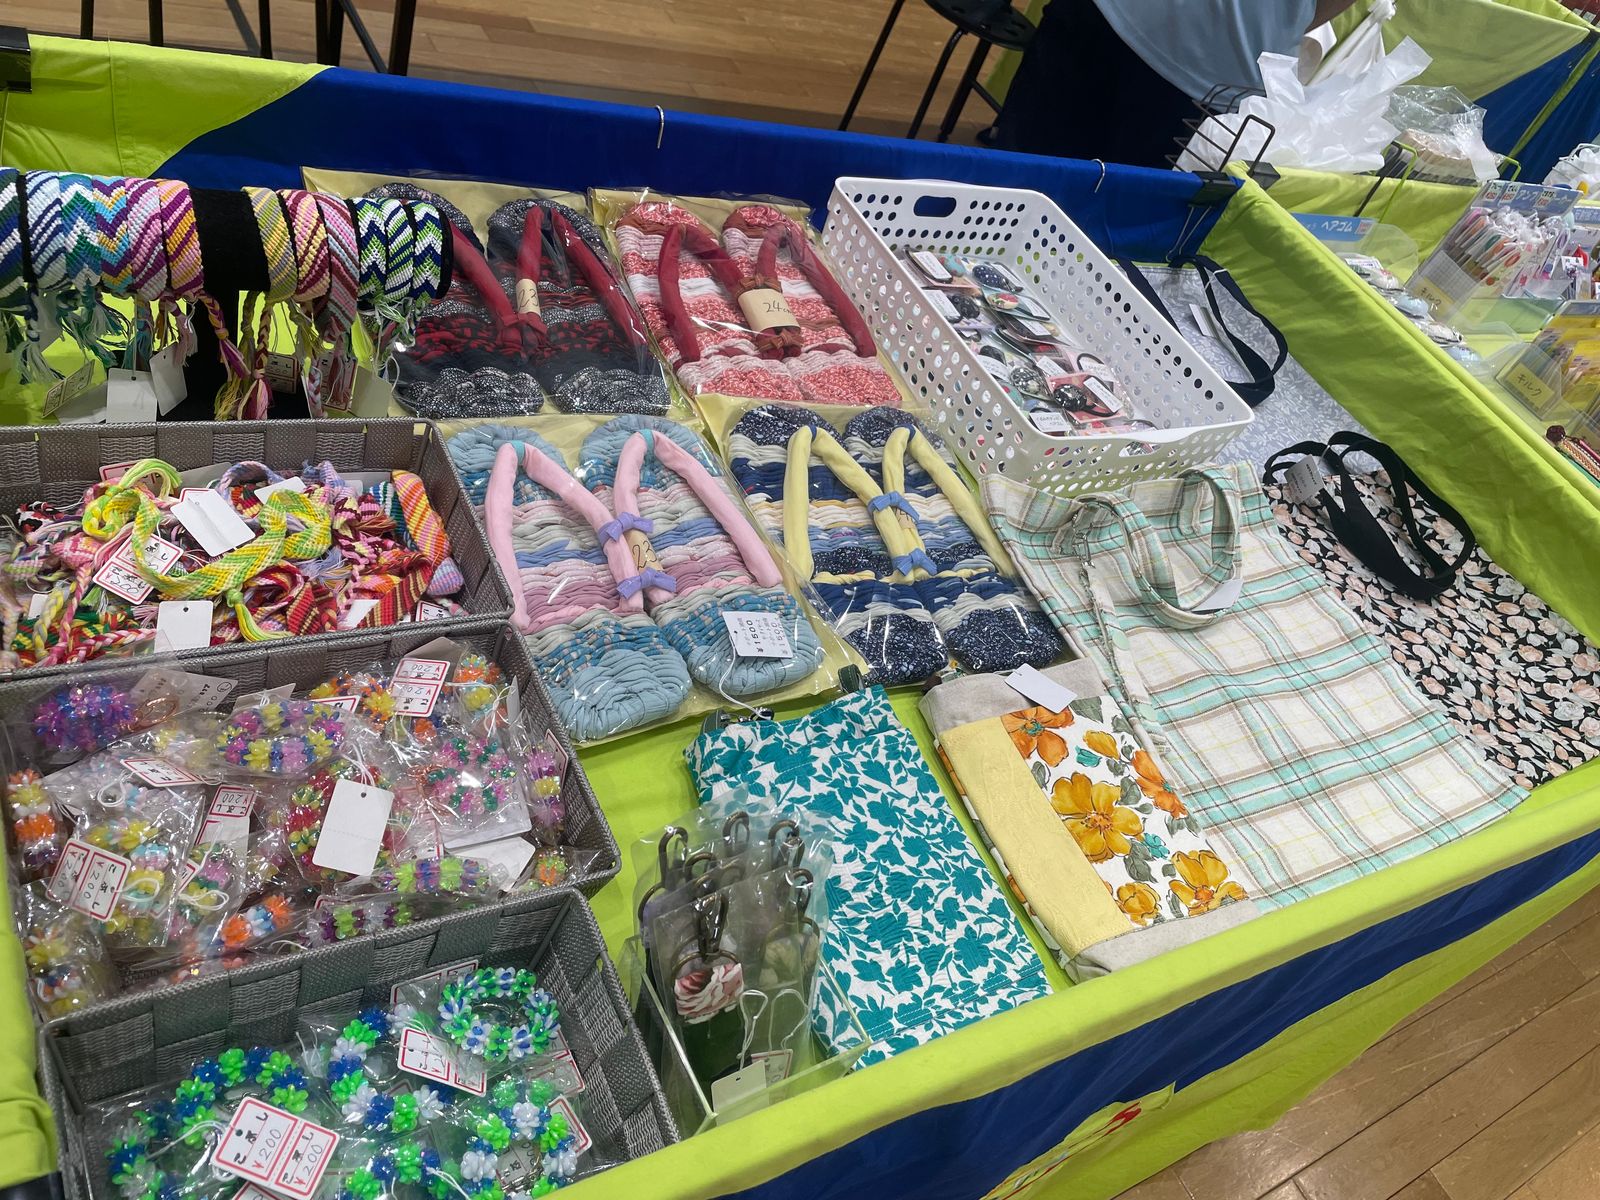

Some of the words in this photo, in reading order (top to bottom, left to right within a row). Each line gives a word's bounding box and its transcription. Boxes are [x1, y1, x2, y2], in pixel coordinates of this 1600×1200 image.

[518, 289, 539, 308] 23
[631, 540, 657, 571] 23
[745, 619, 764, 653] ¥1500
[221, 793, 249, 805] ¥200
[83, 861, 105, 899] ¥200
[233, 1111, 269, 1165] こぶし
[252, 1128, 282, 1169] ¥200
[281, 1131, 314, 1185] こぶし
[293, 1144, 323, 1186] ¥200
